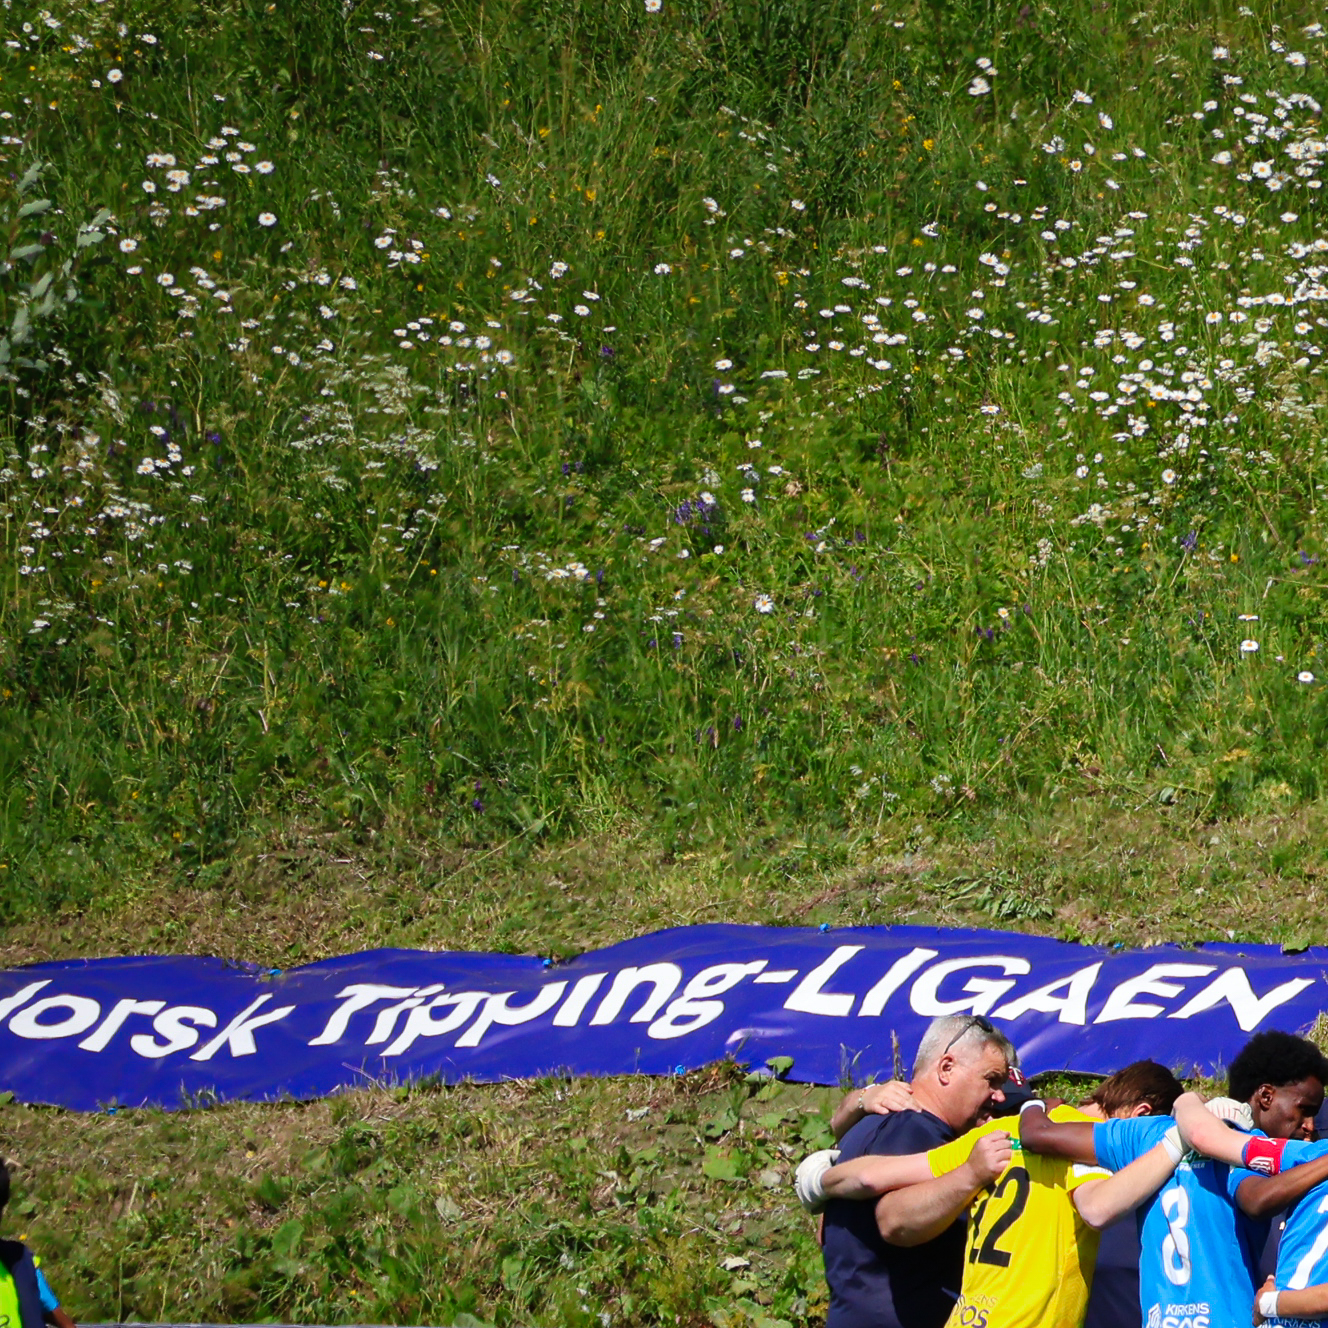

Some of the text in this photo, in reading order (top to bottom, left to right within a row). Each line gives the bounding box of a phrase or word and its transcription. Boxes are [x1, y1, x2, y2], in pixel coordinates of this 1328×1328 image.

[968, 1166, 1030, 1268] 12
[1161, 1185, 1191, 1286] 8
[1165, 1303, 1210, 1315] KIRKENS
